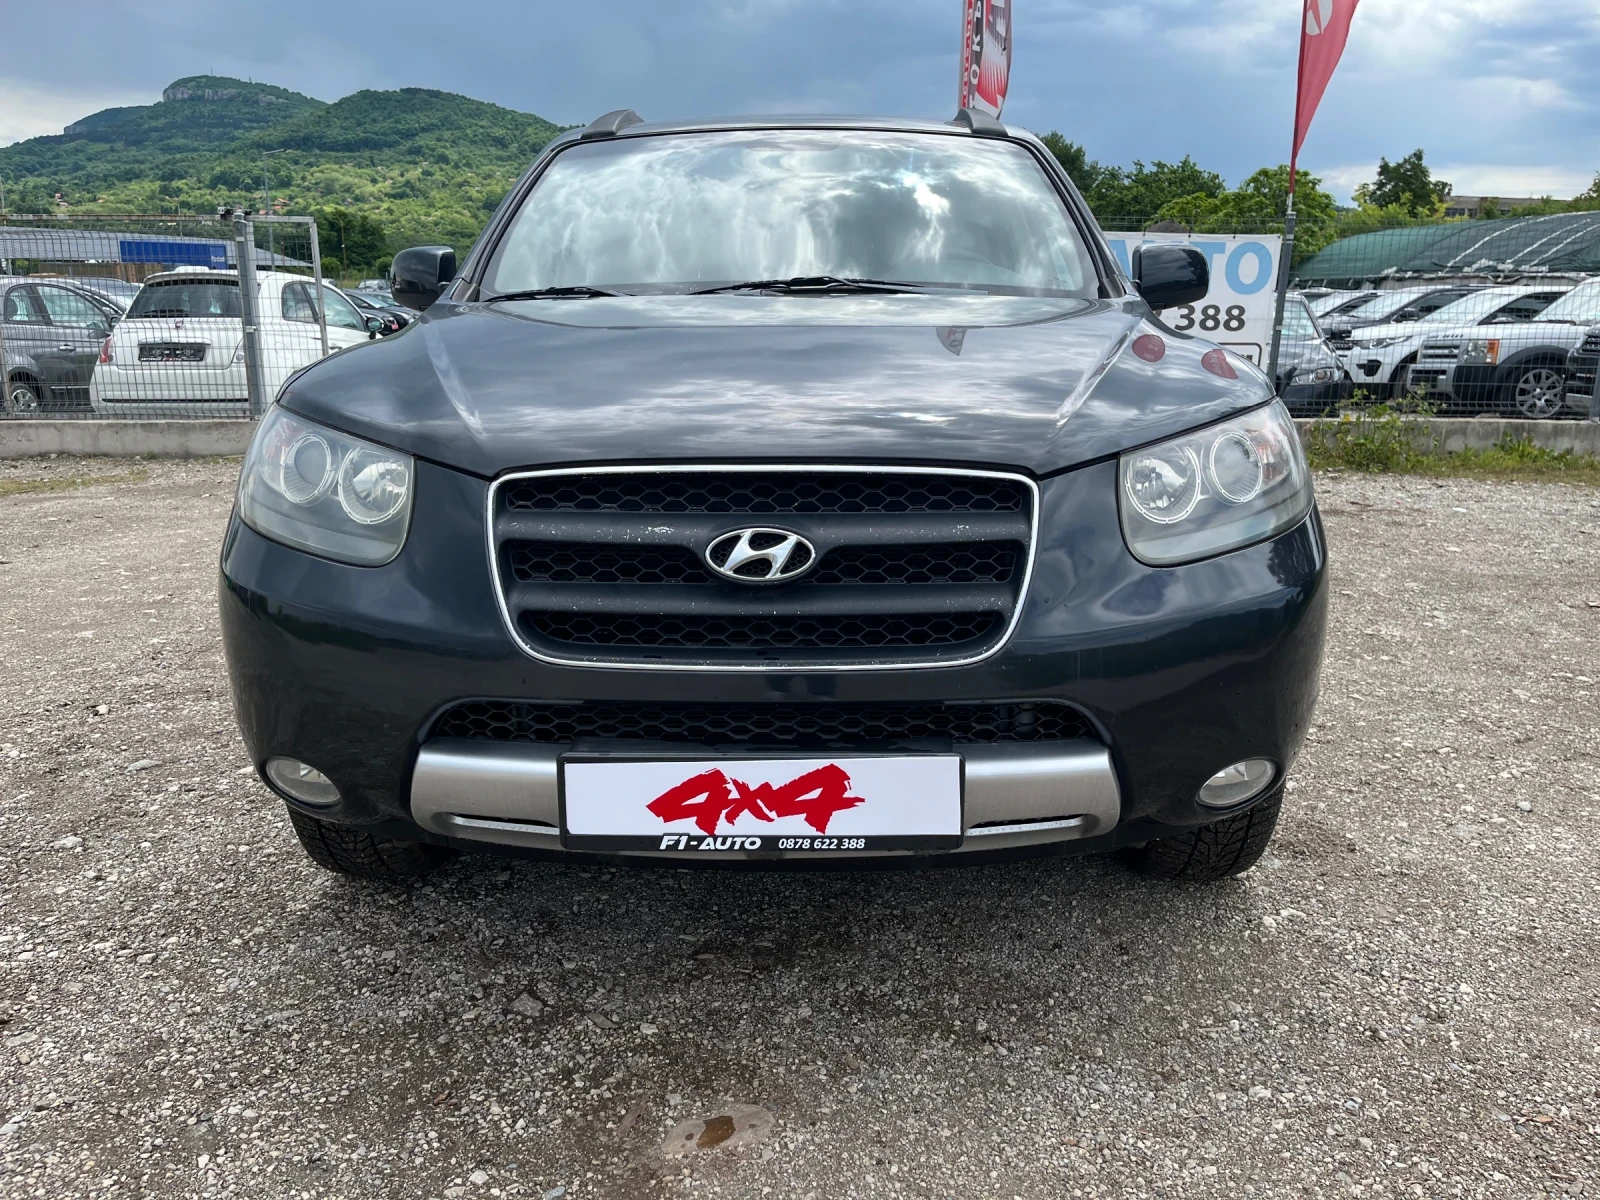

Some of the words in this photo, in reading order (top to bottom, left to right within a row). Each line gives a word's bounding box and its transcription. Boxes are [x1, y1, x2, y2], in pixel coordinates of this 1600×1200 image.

[1174, 304, 1246, 332] 388
[659, 836, 762, 850] F1-AUTO
[778, 838, 810, 849] 0878
[813, 838, 838, 849] 622
[840, 838, 866, 849] 388
